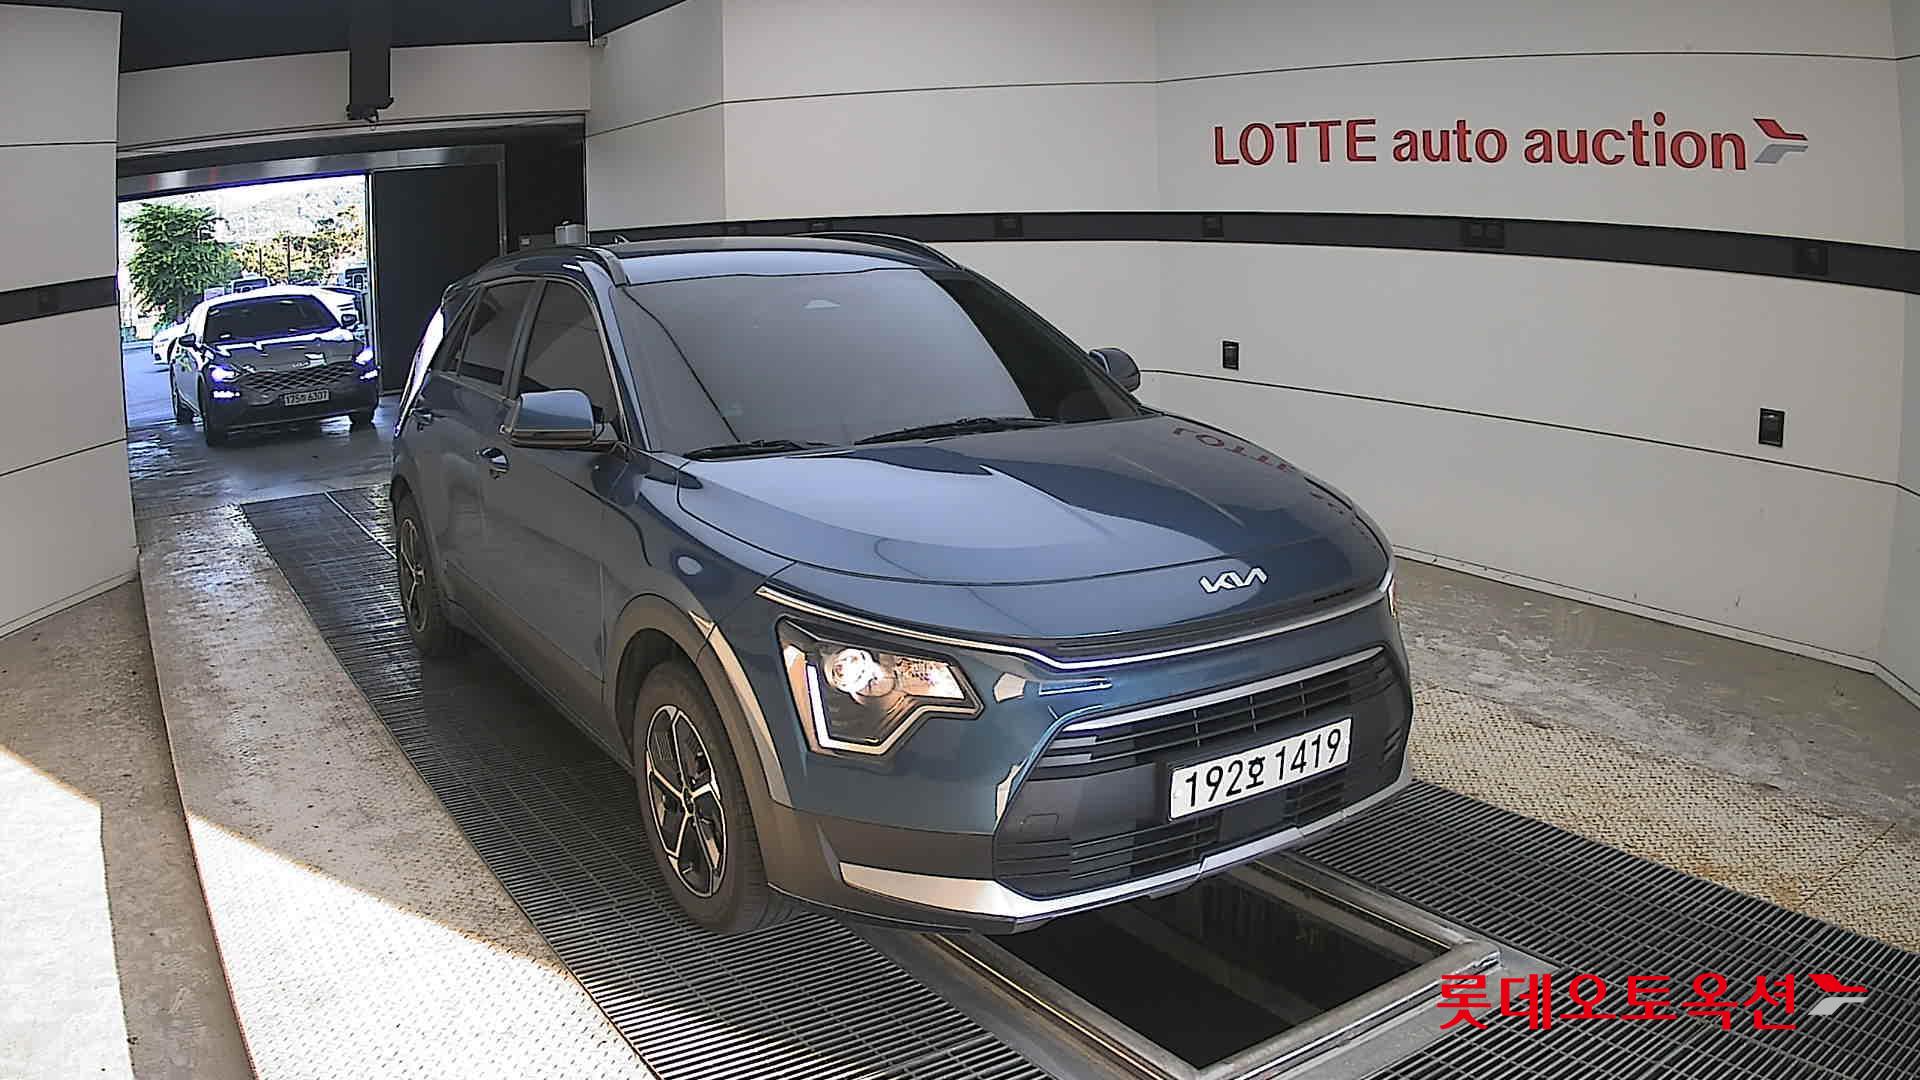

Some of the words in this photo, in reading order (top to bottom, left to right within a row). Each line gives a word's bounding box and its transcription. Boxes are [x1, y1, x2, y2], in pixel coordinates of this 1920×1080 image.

[1214, 118, 1377, 166] LOTTE
[1392, 119, 1508, 164] auto
[1523, 111, 1747, 171] auction
[1198, 564, 1268, 593] KIA
[1185, 756, 1266, 807] 192호
[1274, 729, 1341, 780] 1419
